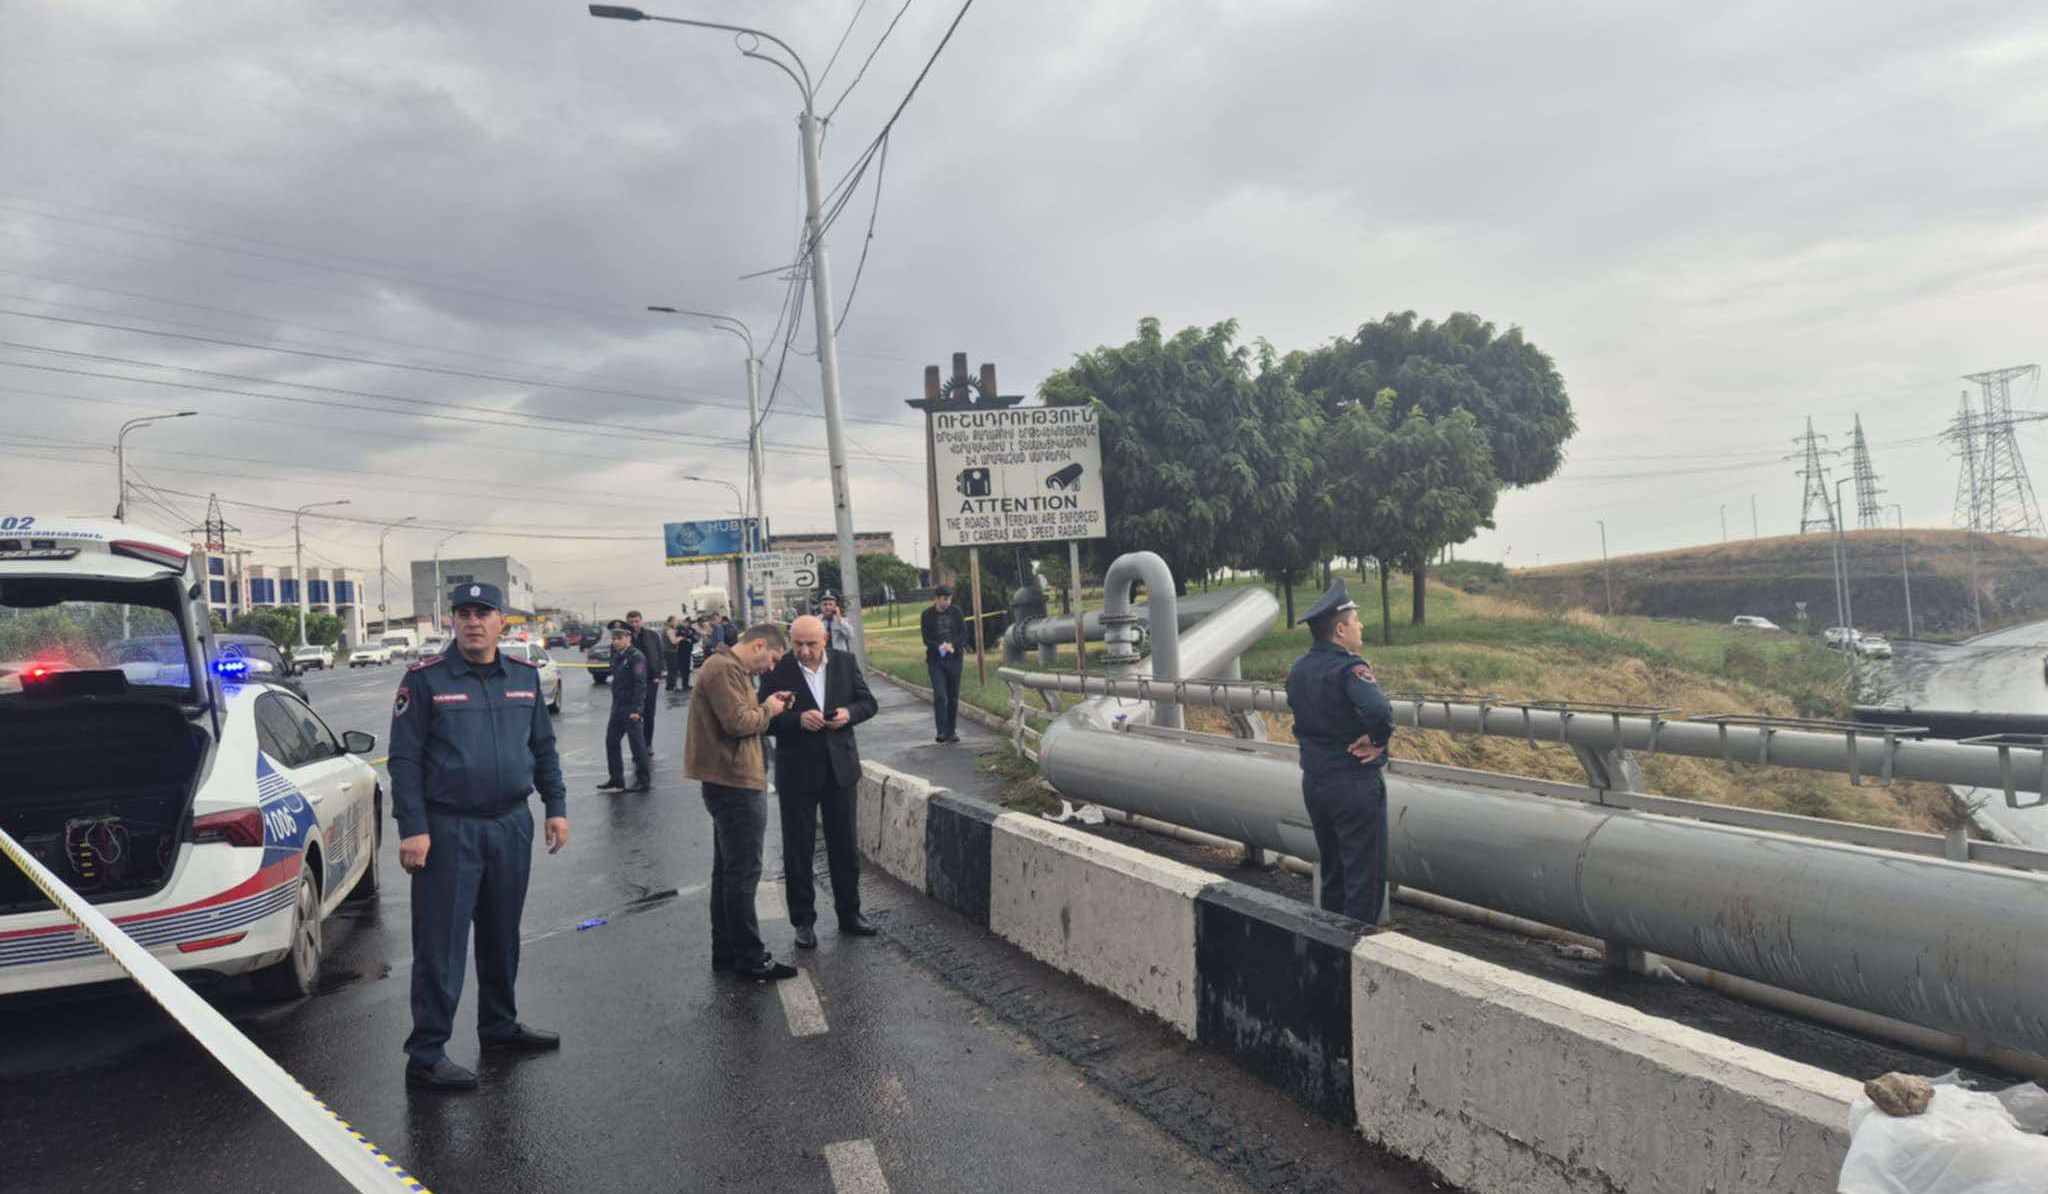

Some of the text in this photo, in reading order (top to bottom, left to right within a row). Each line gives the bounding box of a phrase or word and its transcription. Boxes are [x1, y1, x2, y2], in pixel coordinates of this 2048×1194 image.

[937, 410, 1093, 429] ՈՒՇԱԴՐՈՒԹՅՈՒՆ
[960, 495, 1078, 514] ATTENTION
[947, 518, 961, 530] THE
[965, 516, 990, 529] ROADS
[993, 516, 1002, 527] IN
[1042, 512, 1056, 524] ARE
[1060, 510, 1098, 524] ENFORCED
[959, 524, 1088, 542] BY CAMERAS AND SPEED RADARS
[265, 807, 298, 842] 1006
